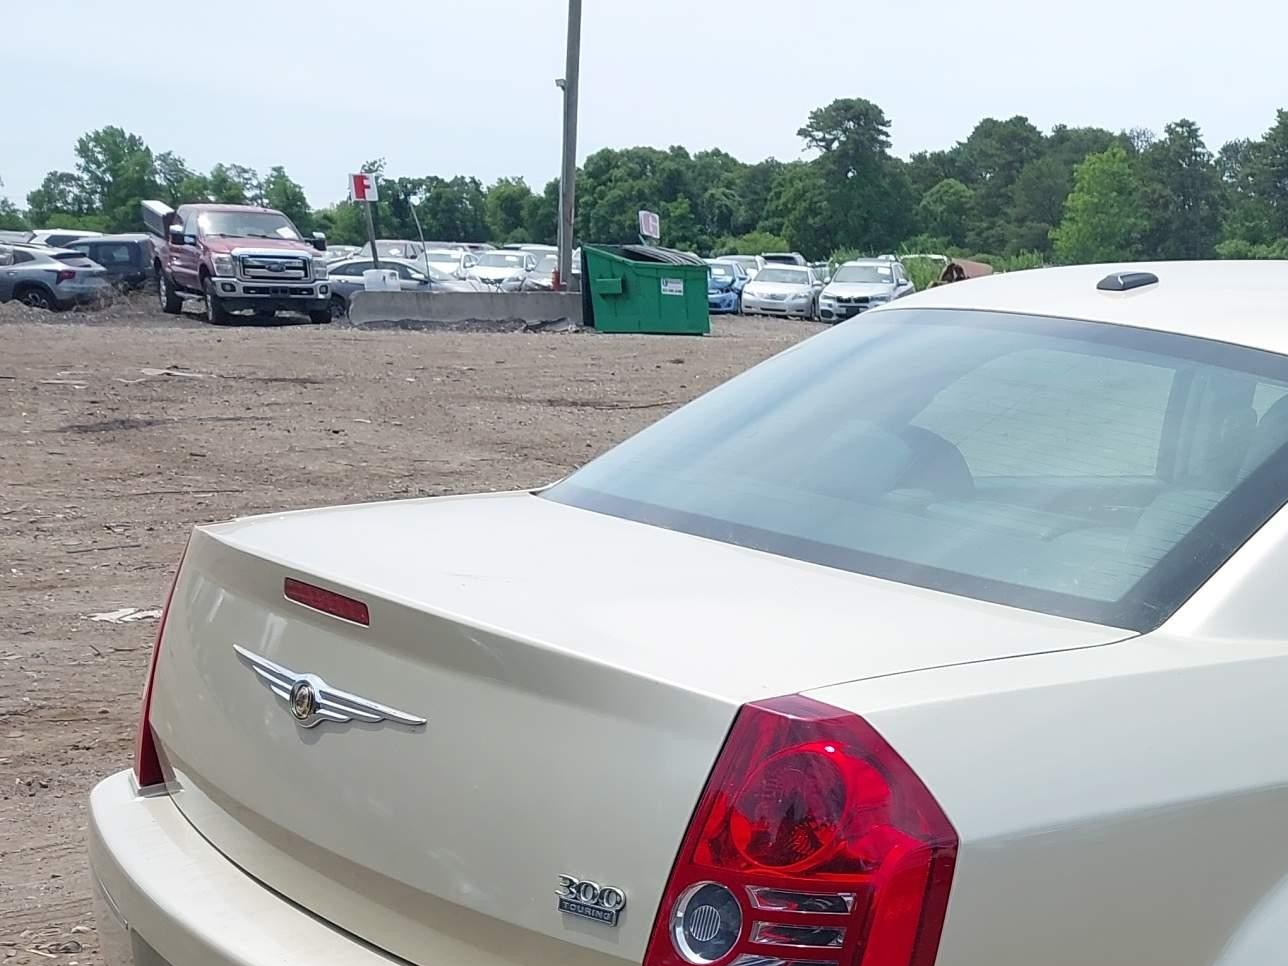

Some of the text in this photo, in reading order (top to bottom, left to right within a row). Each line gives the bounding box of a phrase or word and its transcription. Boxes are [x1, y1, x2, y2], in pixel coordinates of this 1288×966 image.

[352, 175, 371, 199] F
[555, 873, 626, 910] 300
[561, 901, 611, 920] TOURING
